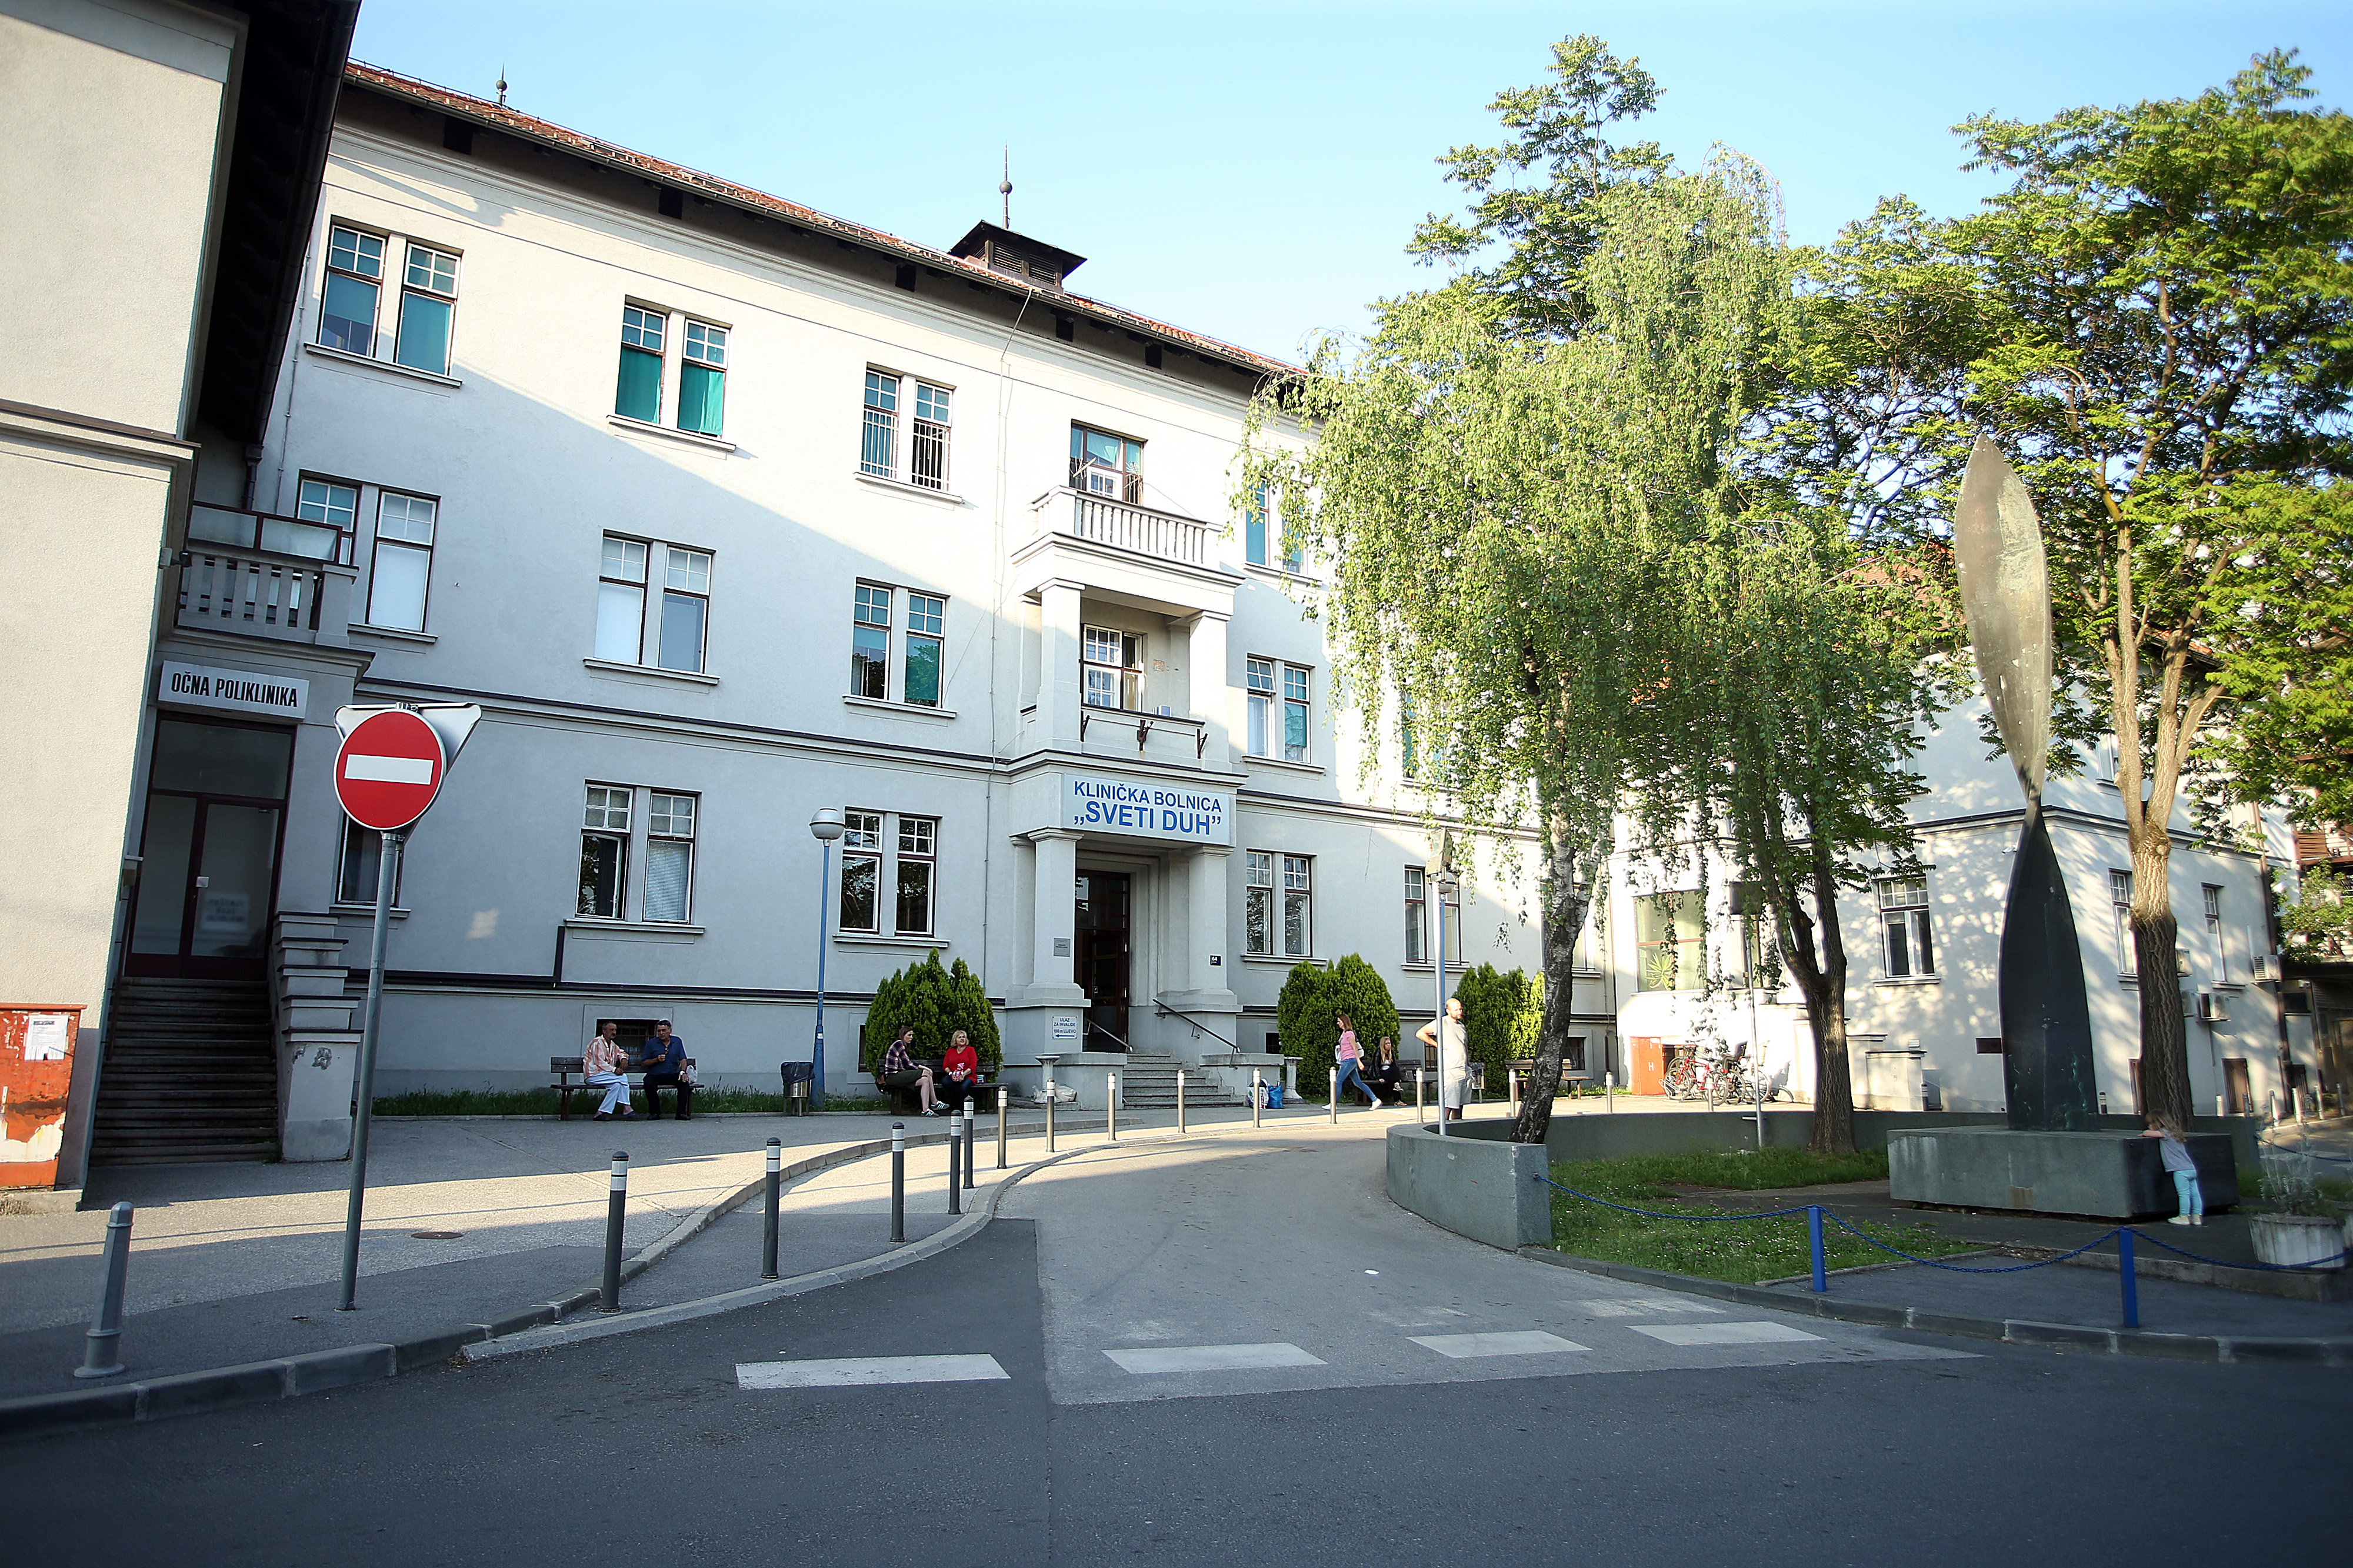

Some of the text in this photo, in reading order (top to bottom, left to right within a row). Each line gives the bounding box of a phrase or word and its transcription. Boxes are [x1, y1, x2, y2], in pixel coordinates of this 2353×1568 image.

[171, 672, 298, 708] OČNA POLIKLINIKA
[1074, 780, 1222, 813] KLINIČKA BOLNICA
[1648, 1062, 1654, 1071] H
